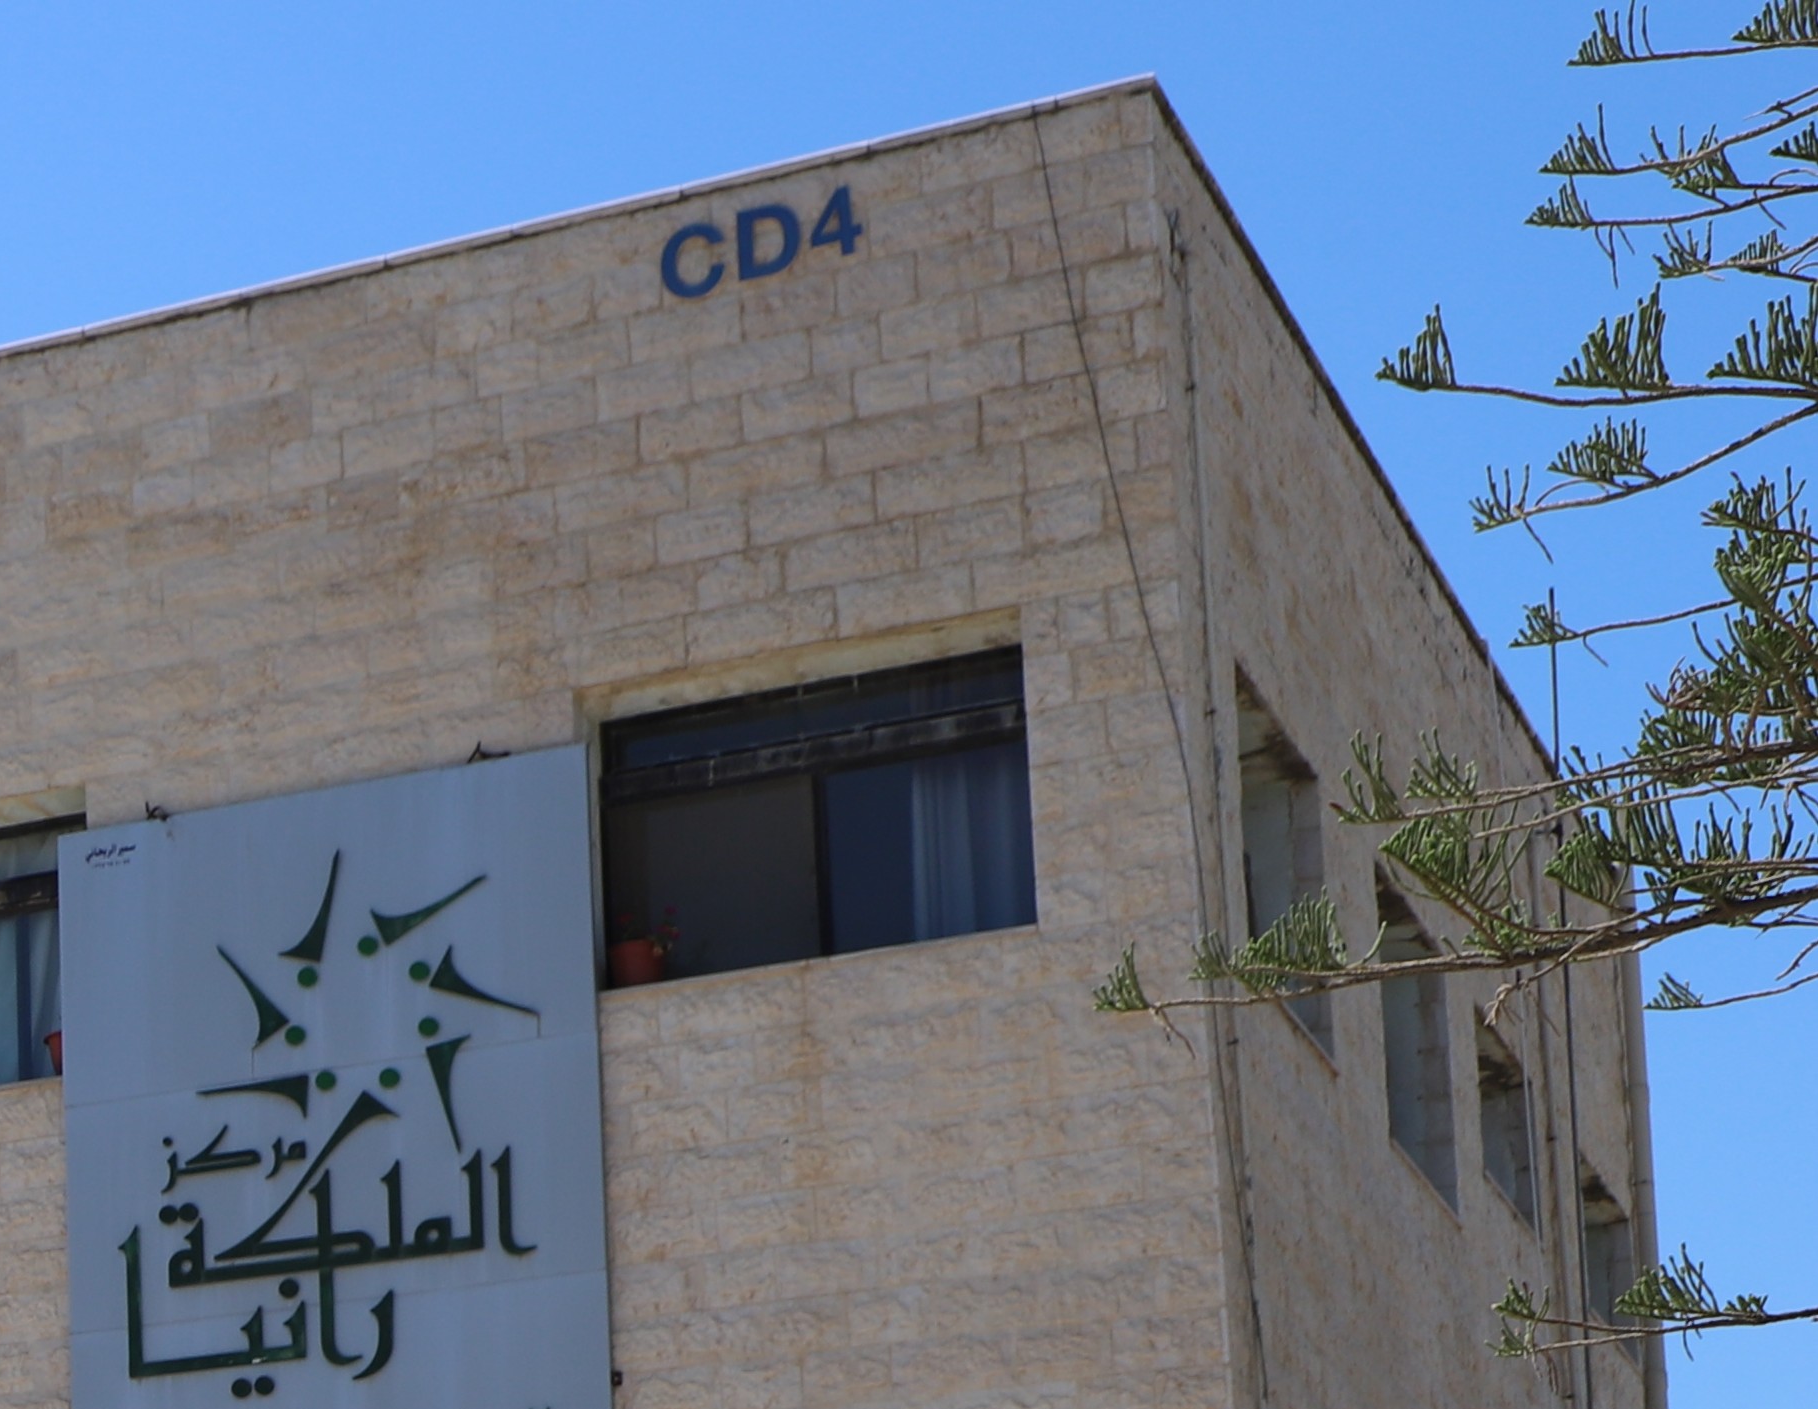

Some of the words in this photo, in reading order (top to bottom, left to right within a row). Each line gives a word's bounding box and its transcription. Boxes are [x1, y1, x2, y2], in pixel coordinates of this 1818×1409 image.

[660, 184, 863, 299] CD4
[158, 1092, 537, 1289] الملكة
[160, 1123, 307, 1194] مركز
[118, 1224, 395, 1398] رانيا
